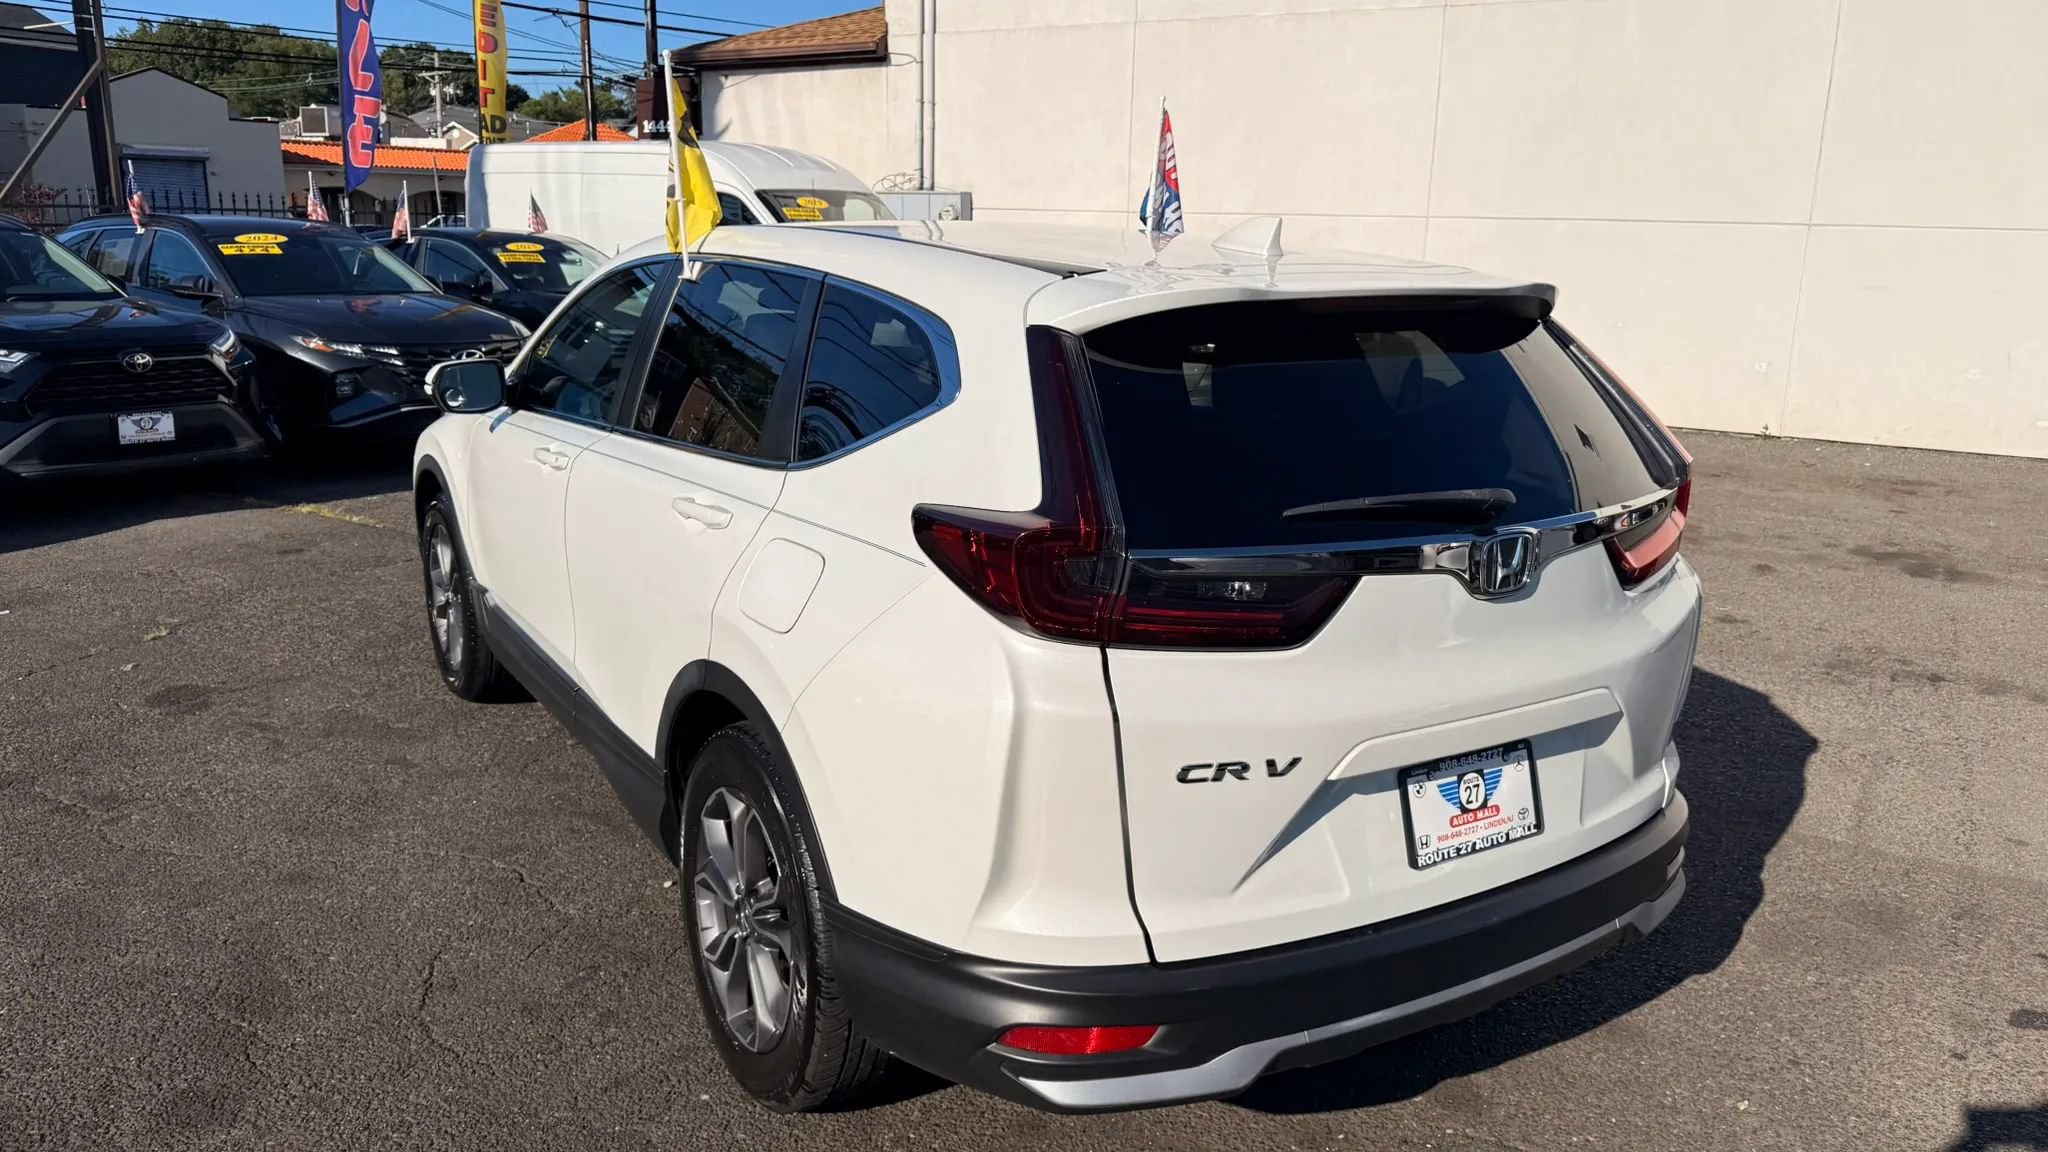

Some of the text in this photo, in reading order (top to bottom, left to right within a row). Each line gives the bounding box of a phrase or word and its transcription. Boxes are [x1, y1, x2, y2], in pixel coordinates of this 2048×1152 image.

[1439, 747, 1504, 772] 908-648-2727
[1463, 776, 1480, 785] ROUTE
[1464, 784, 1480, 805] 27
[1452, 808, 1498, 826] AUTO MALL
[1436, 825, 1479, 843] 908-648-2727
[1417, 823, 1538, 867] ROUTE 27 AUTO MALL
